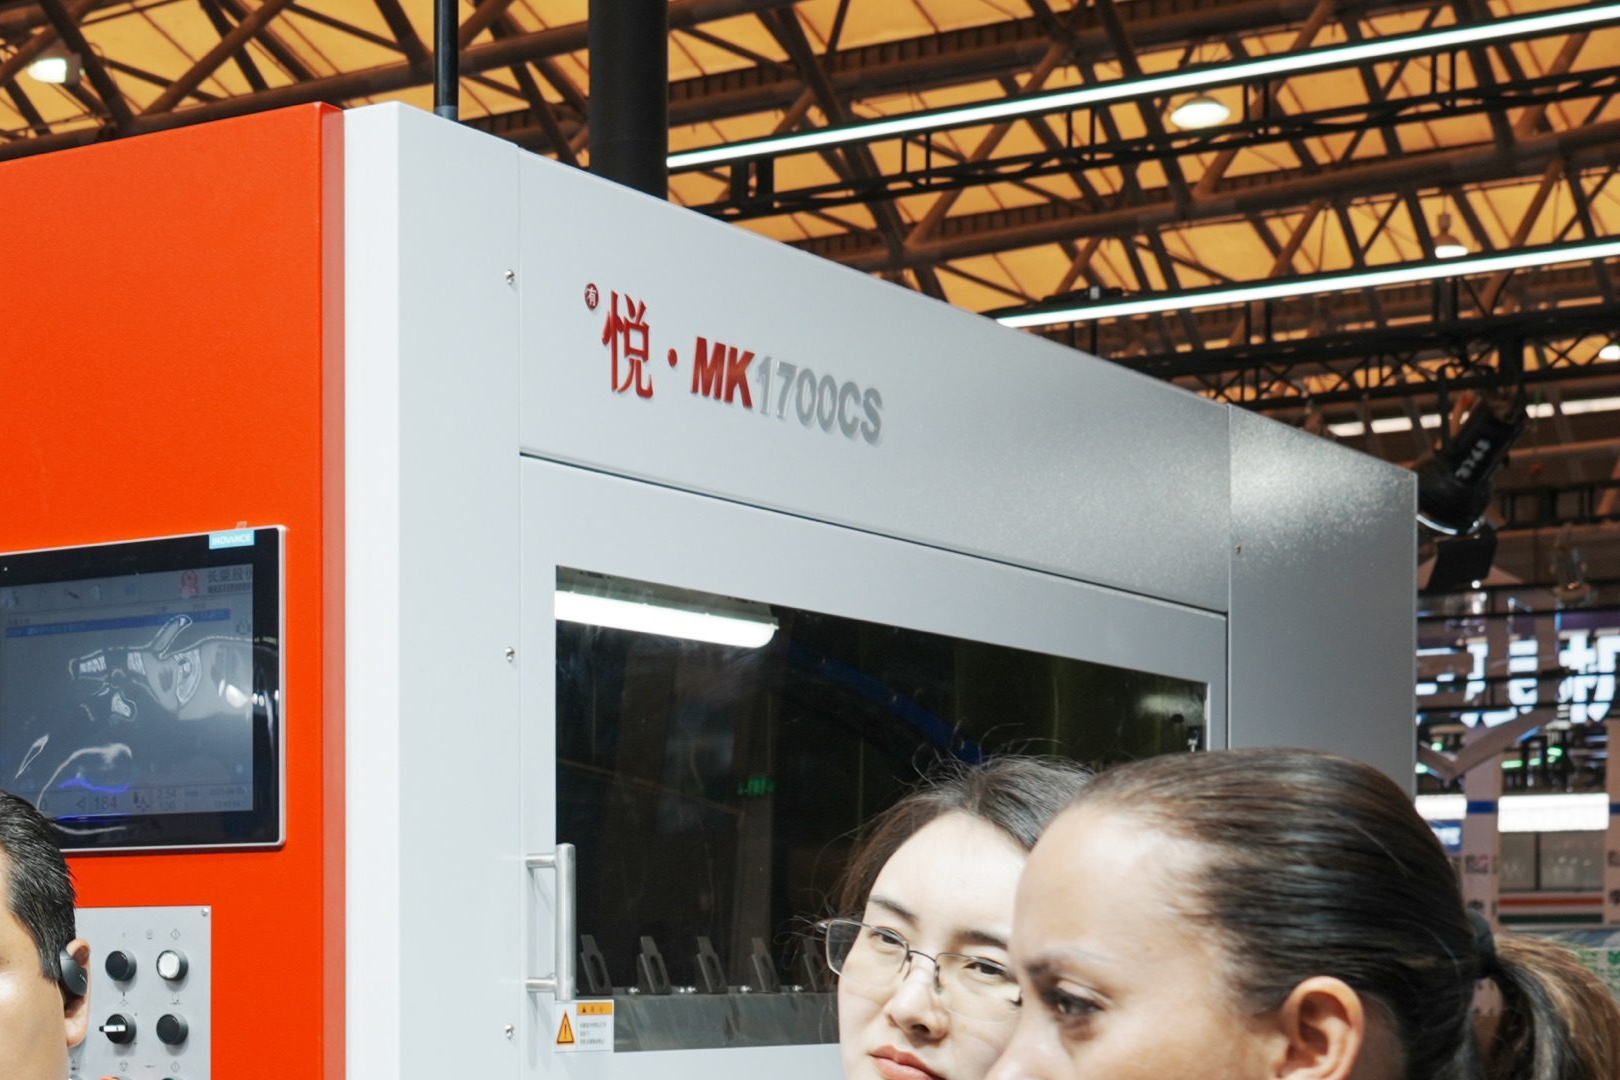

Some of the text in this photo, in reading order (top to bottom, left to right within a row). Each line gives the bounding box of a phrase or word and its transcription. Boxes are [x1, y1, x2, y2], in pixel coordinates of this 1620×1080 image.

[602, 289, 653, 398] 悦
[690, 336, 883, 444] MK1700CS
[211, 533, 252, 544] INOVANCE
[94, 795, 118, 810] 184
